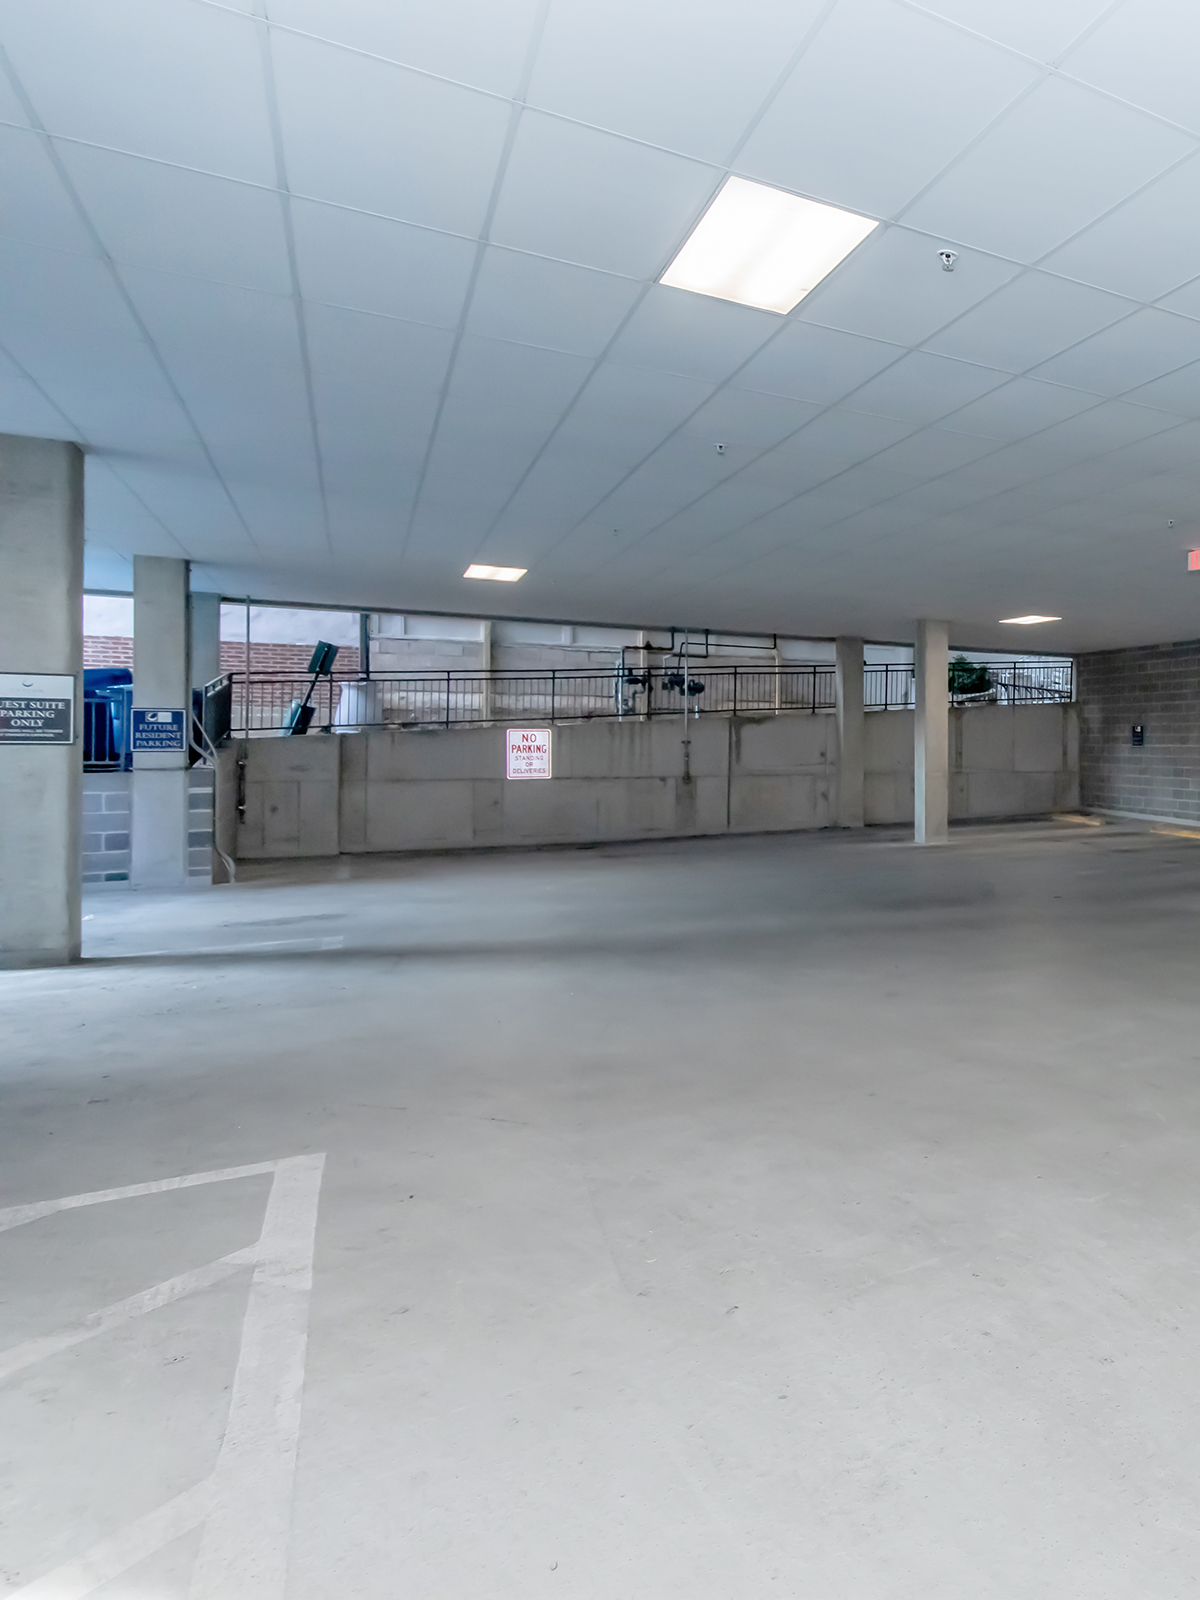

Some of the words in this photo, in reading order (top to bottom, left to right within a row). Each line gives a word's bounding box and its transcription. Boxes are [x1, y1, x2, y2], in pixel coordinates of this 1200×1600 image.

[0, 700, 27, 709] UEST
[29, 701, 66, 709] SUITE
[0, 710, 55, 718] PARKING
[10, 719, 44, 727] ONLY
[135, 731, 182, 739] RESIDENT
[521, 733, 537, 743] NO
[511, 744, 547, 754] PARKING
